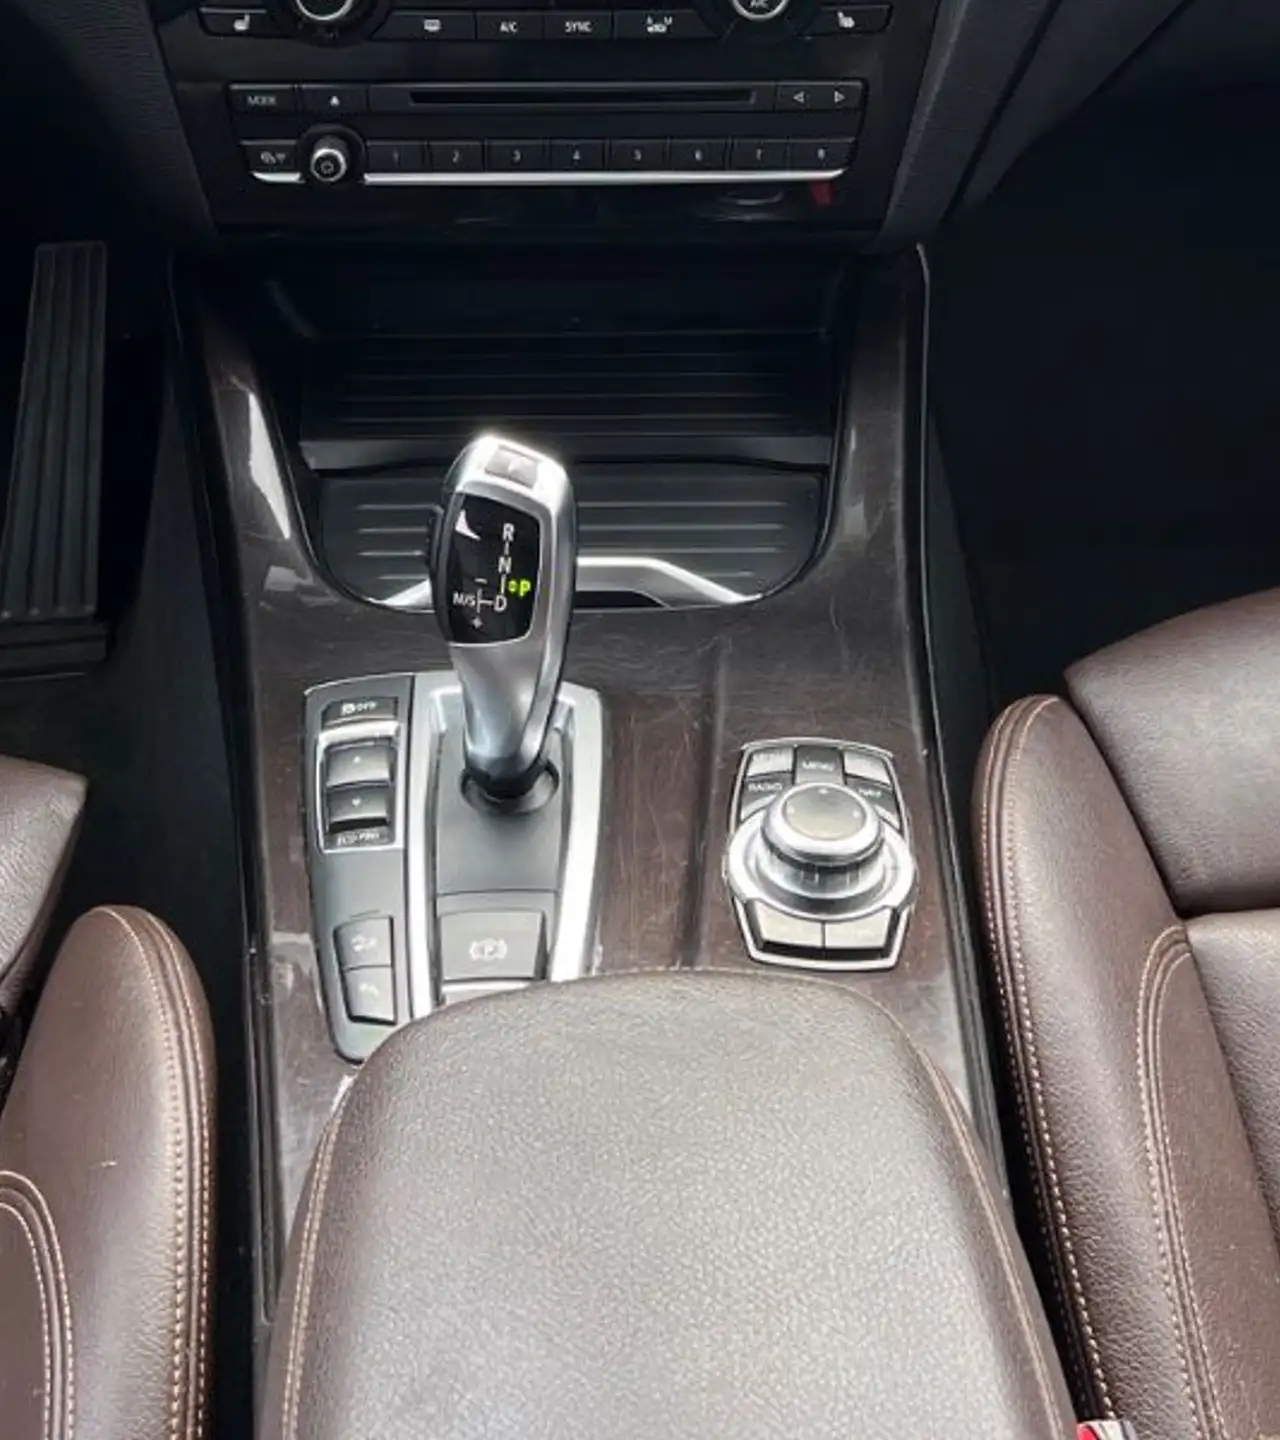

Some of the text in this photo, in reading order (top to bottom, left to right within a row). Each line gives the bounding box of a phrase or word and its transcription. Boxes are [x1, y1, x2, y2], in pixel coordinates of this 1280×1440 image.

[499, 21, 518, 33] A/C
[565, 21, 593, 33] SYNC
[503, 523, 514, 541] R
[498, 556, 512, 574] N
[452, 592, 507, 612] M/S D
